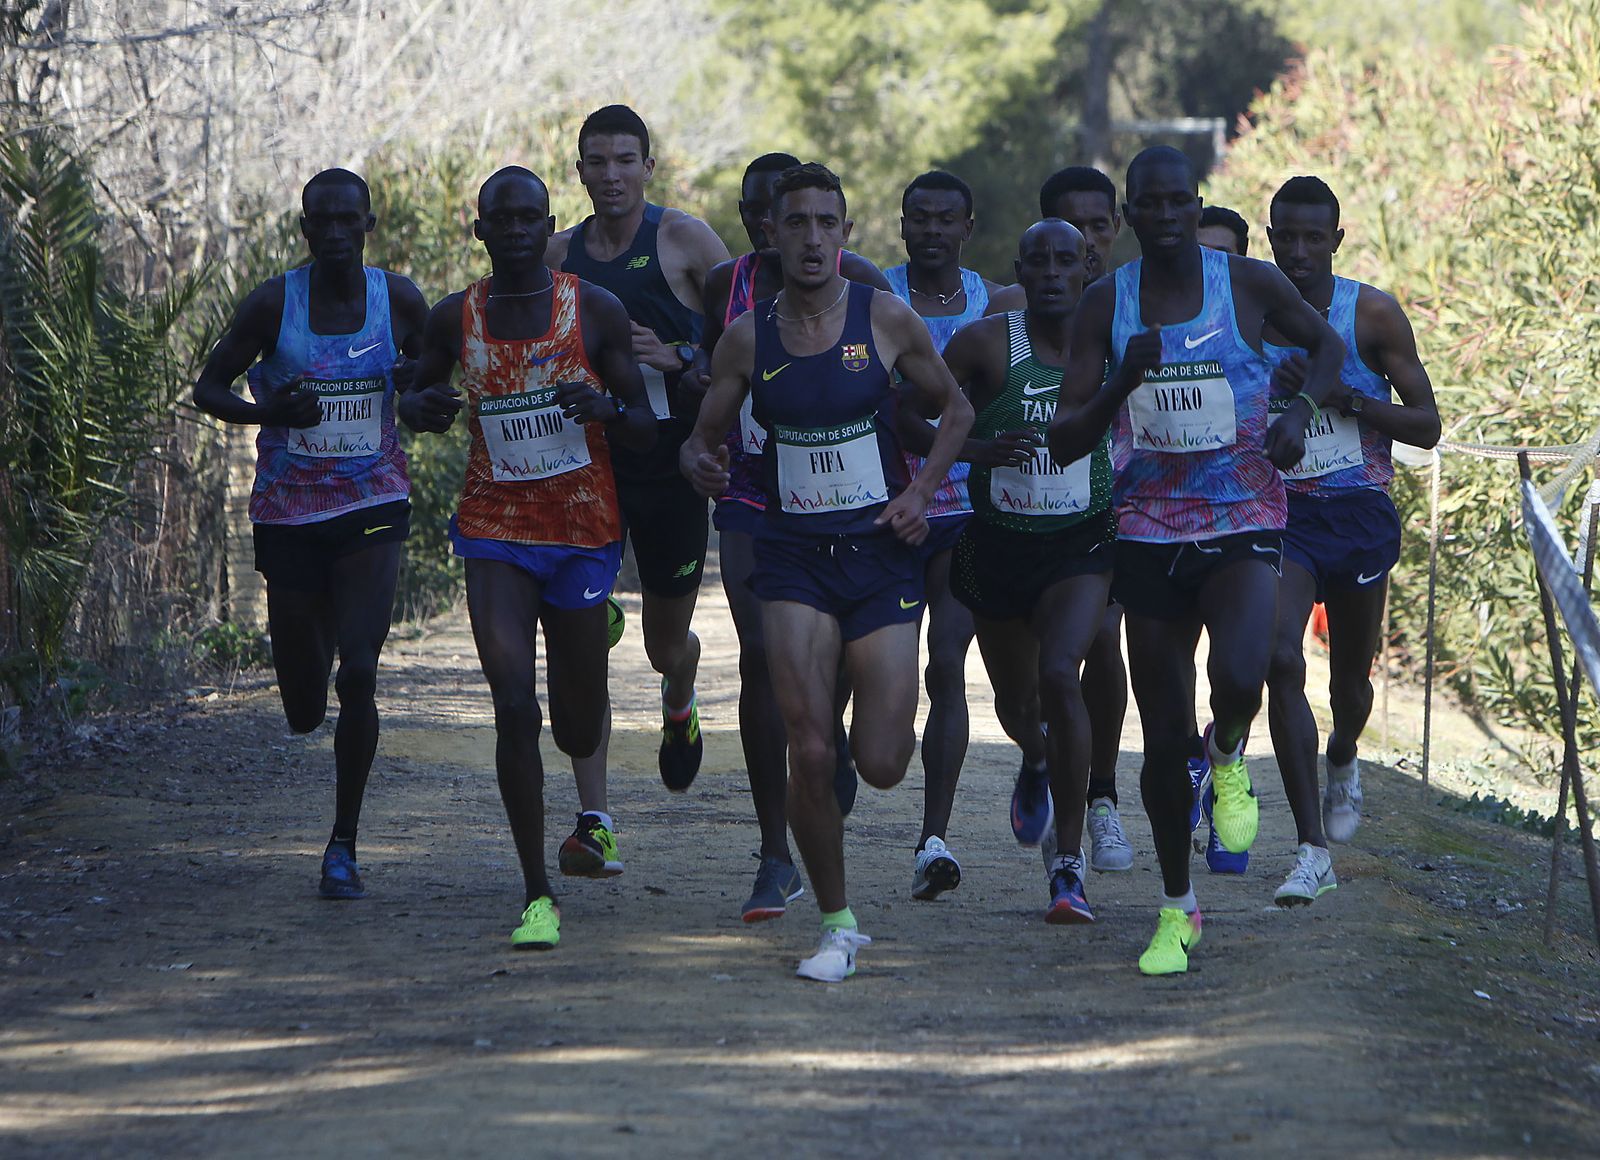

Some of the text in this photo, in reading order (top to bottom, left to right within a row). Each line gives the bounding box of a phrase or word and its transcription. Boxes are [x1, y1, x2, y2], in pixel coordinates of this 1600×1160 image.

[1180, 365, 1191, 377] DE
[1194, 362, 1223, 376] SEVILL
[343, 381, 353, 391] DE
[355, 380, 382, 390] SEVILLA
[319, 398, 372, 422] EPTEGEI
[481, 396, 529, 411] DIPUTACION
[531, 394, 543, 405] DE
[1154, 386, 1203, 412] AYEKO
[501, 410, 563, 441] KIPLIMO
[779, 428, 827, 443] DIPUTACION
[828, 430, 840, 441] DE
[842, 419, 873, 438] SEVILLA
[1140, 426, 1225, 448] Andalucía
[295, 433, 374, 454] Andalucía
[500, 448, 582, 478] Andalucía
[809, 450, 845, 474] FIFA
[788, 484, 882, 511] Andalucía
[1000, 487, 1080, 511] Andalucía
